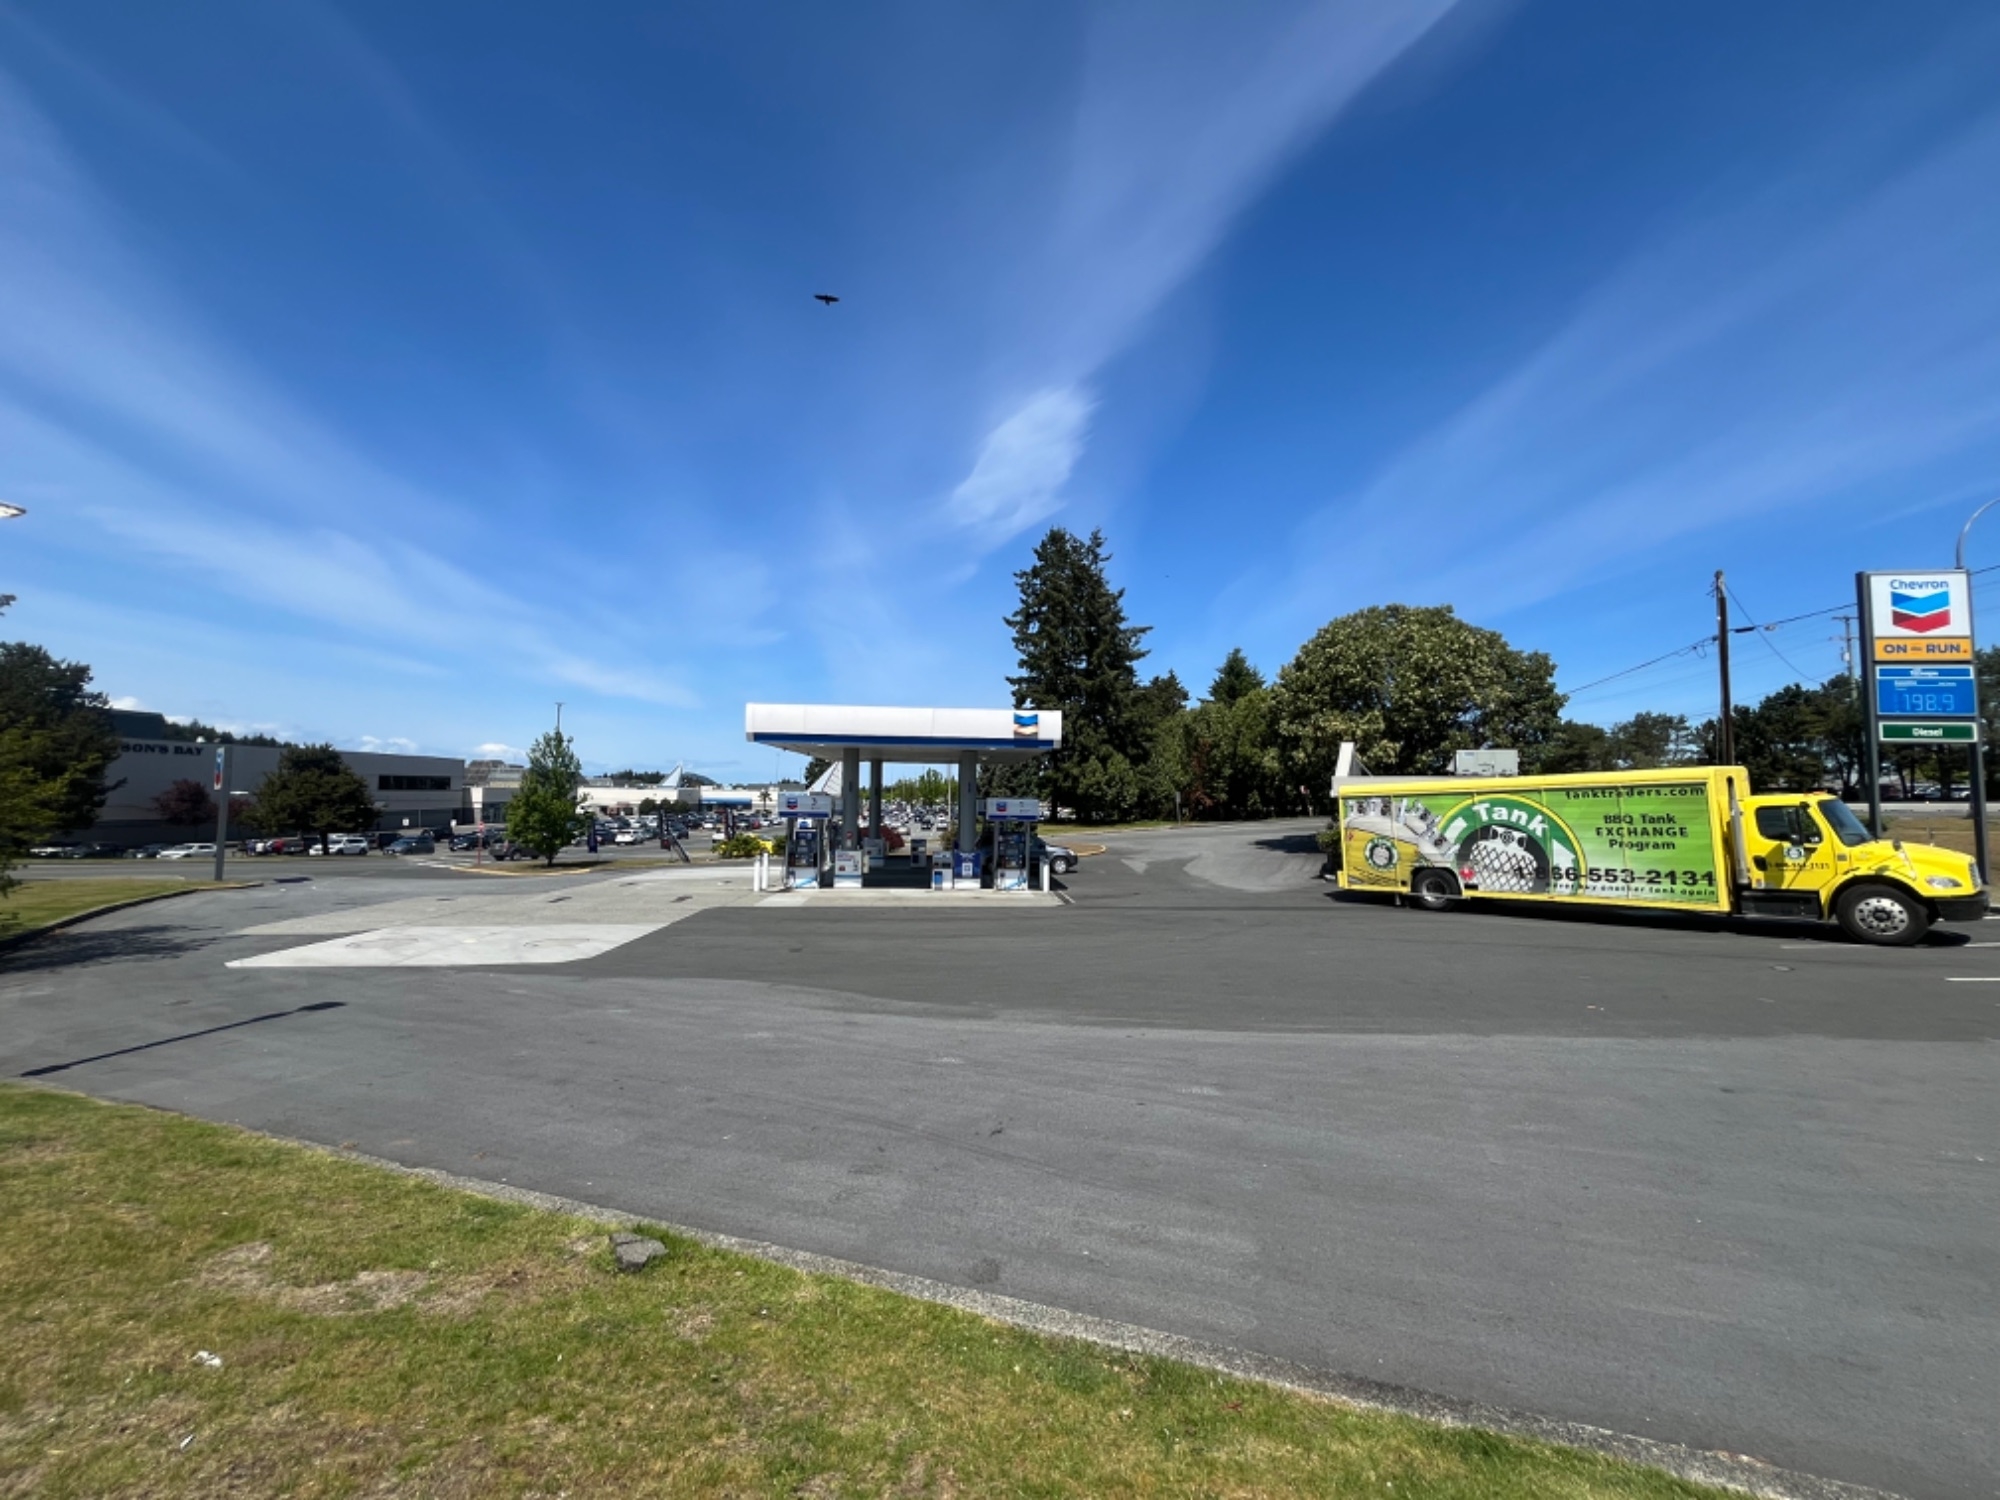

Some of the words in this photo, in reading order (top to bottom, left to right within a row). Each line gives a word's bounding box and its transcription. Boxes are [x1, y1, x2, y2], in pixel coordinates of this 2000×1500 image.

[1890, 579, 1949, 590] Chevron
[1883, 644, 1907, 653] ON
[1903, 694, 1955, 711] 198.9
[1912, 728, 1943, 737] Diesel
[120, 743, 169, 754] SON'S
[174, 745, 204, 756] BAY
[1565, 786, 1705, 800] tanktraders.com
[1472, 803, 1548, 838] Tank
[1603, 813, 1634, 825] BBQ
[1640, 813, 1676, 824] Tank
[1595, 827, 1688, 837] EXCHANGE
[1608, 839, 1676, 851] Program
